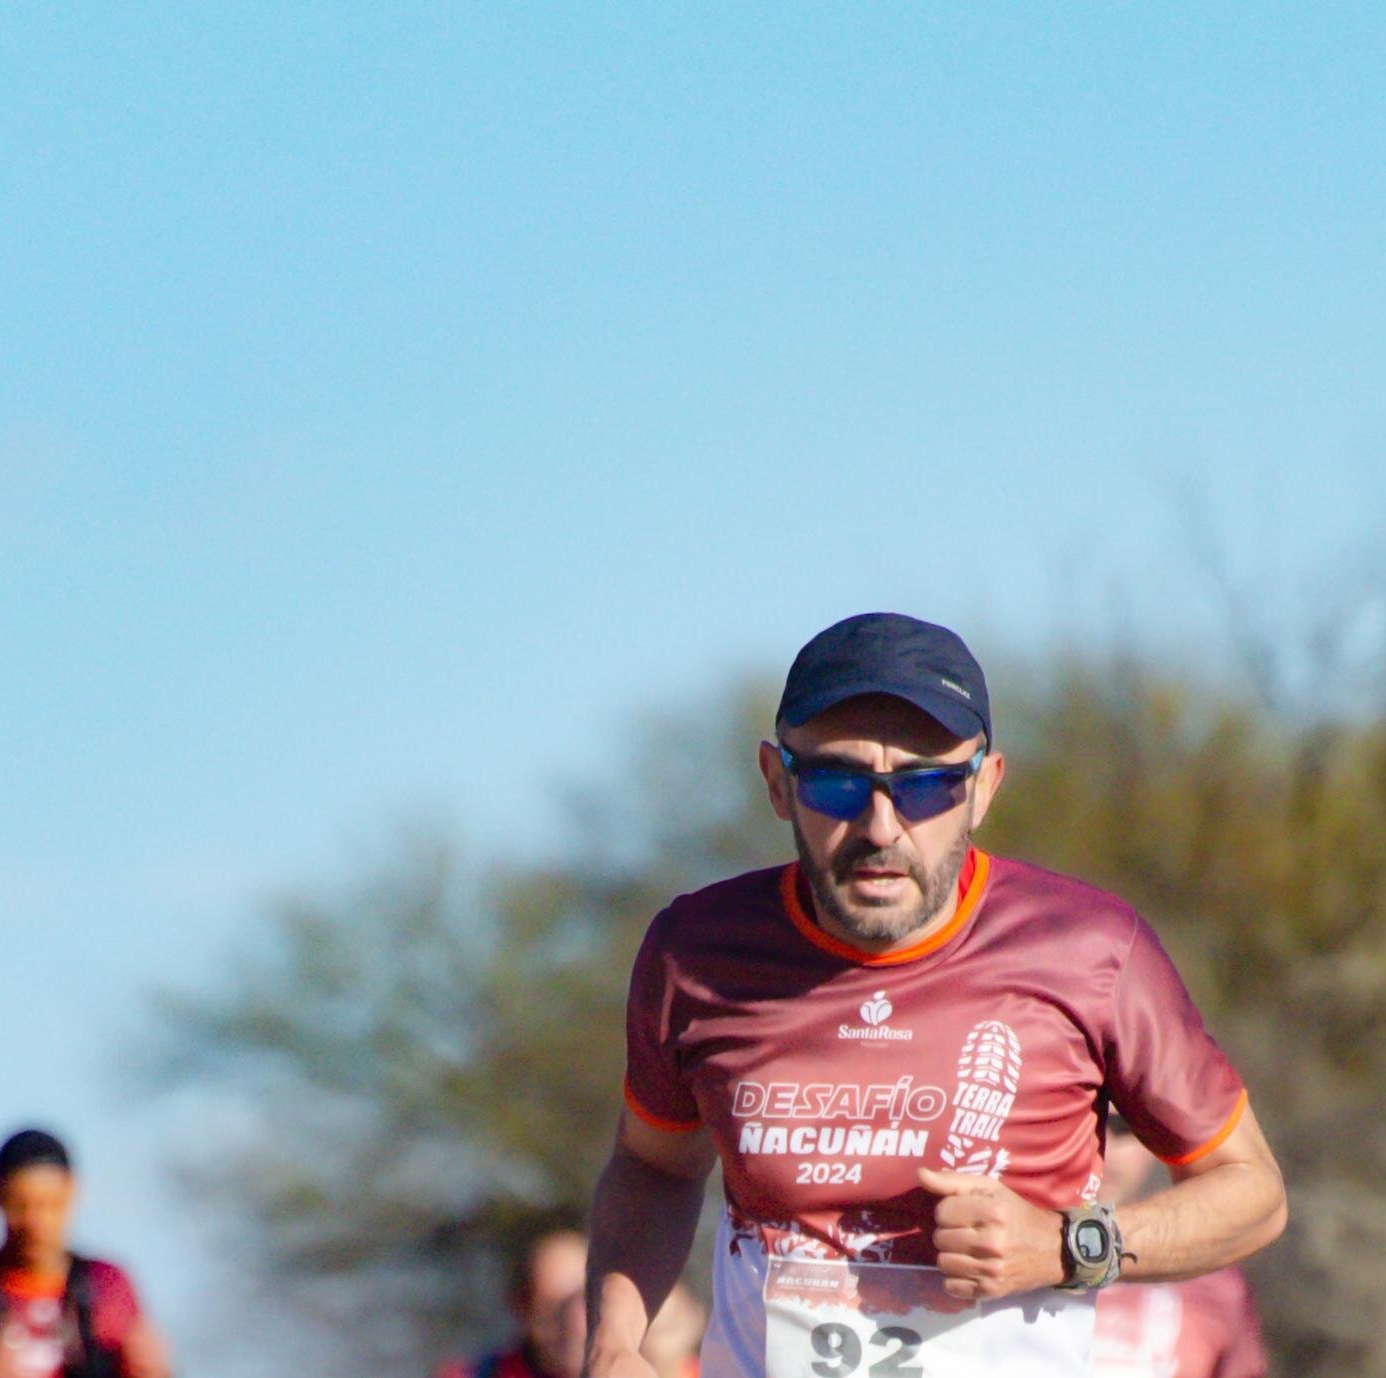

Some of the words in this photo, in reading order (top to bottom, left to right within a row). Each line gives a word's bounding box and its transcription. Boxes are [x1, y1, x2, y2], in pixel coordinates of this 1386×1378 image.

[838, 1024, 912, 1041] SantaRosa
[732, 1075, 947, 1121] DESAFÍO
[952, 1081, 1017, 1119] TERRA
[739, 1120, 929, 1157] ÑACUÑÁN
[949, 1108, 1006, 1142] TRAIL
[796, 1162, 862, 1184] 2024
